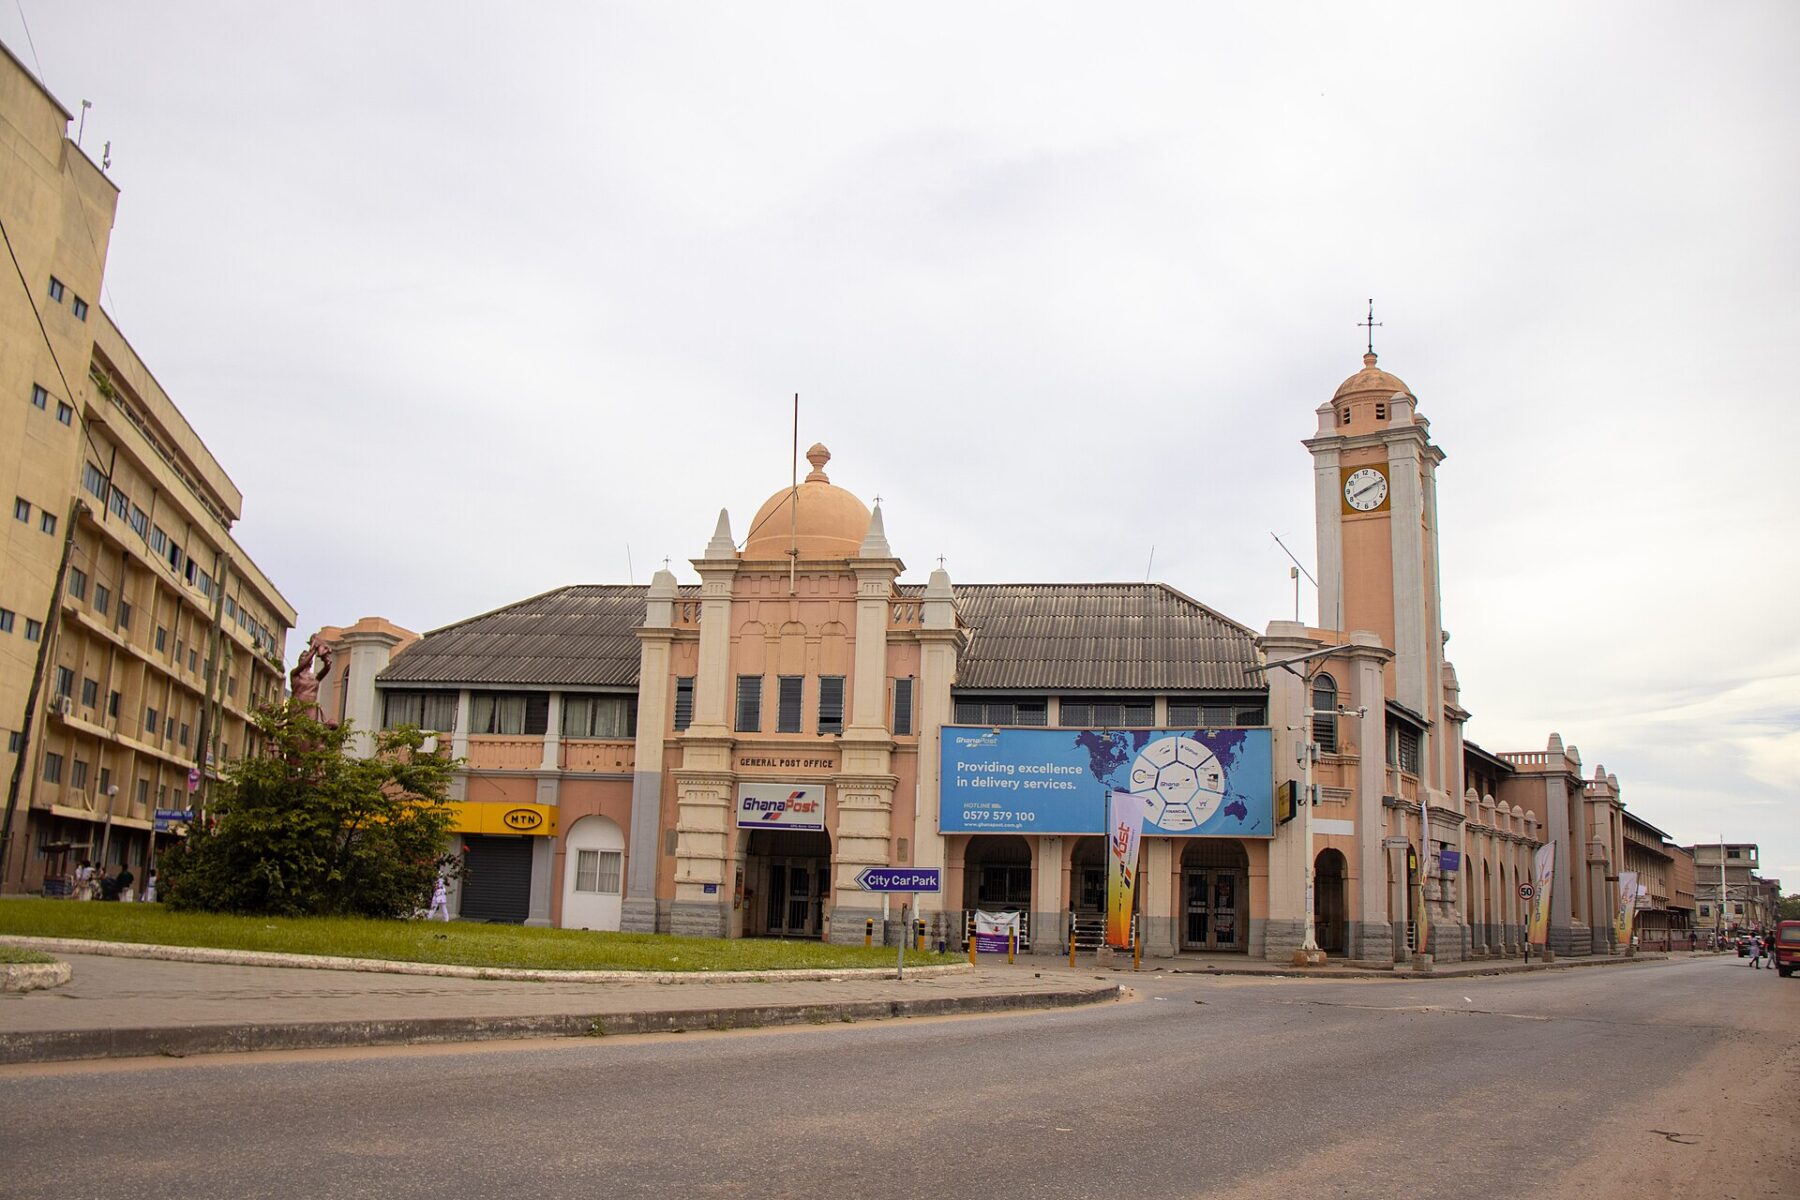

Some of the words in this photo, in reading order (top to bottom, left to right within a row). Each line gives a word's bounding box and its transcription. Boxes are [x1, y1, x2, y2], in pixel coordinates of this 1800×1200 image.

[740, 758, 776, 766] GENERAL
[804, 760, 833, 768] OFFICE
[957, 762, 1014, 774] Providing
[1018, 763, 1083, 774] excellence
[956, 776, 968, 787] in
[972, 777, 1020, 790] delivery
[1024, 779, 1076, 790] services.
[743, 798, 819, 813] GhanaPost
[963, 811, 990, 820] 0579
[992, 812, 1012, 820] 579
[1016, 812, 1035, 821] 100
[868, 875, 890, 887] City
[892, 876, 910, 885] Car
[912, 876, 936, 886] Park
[1521, 887, 1532, 896] 50
